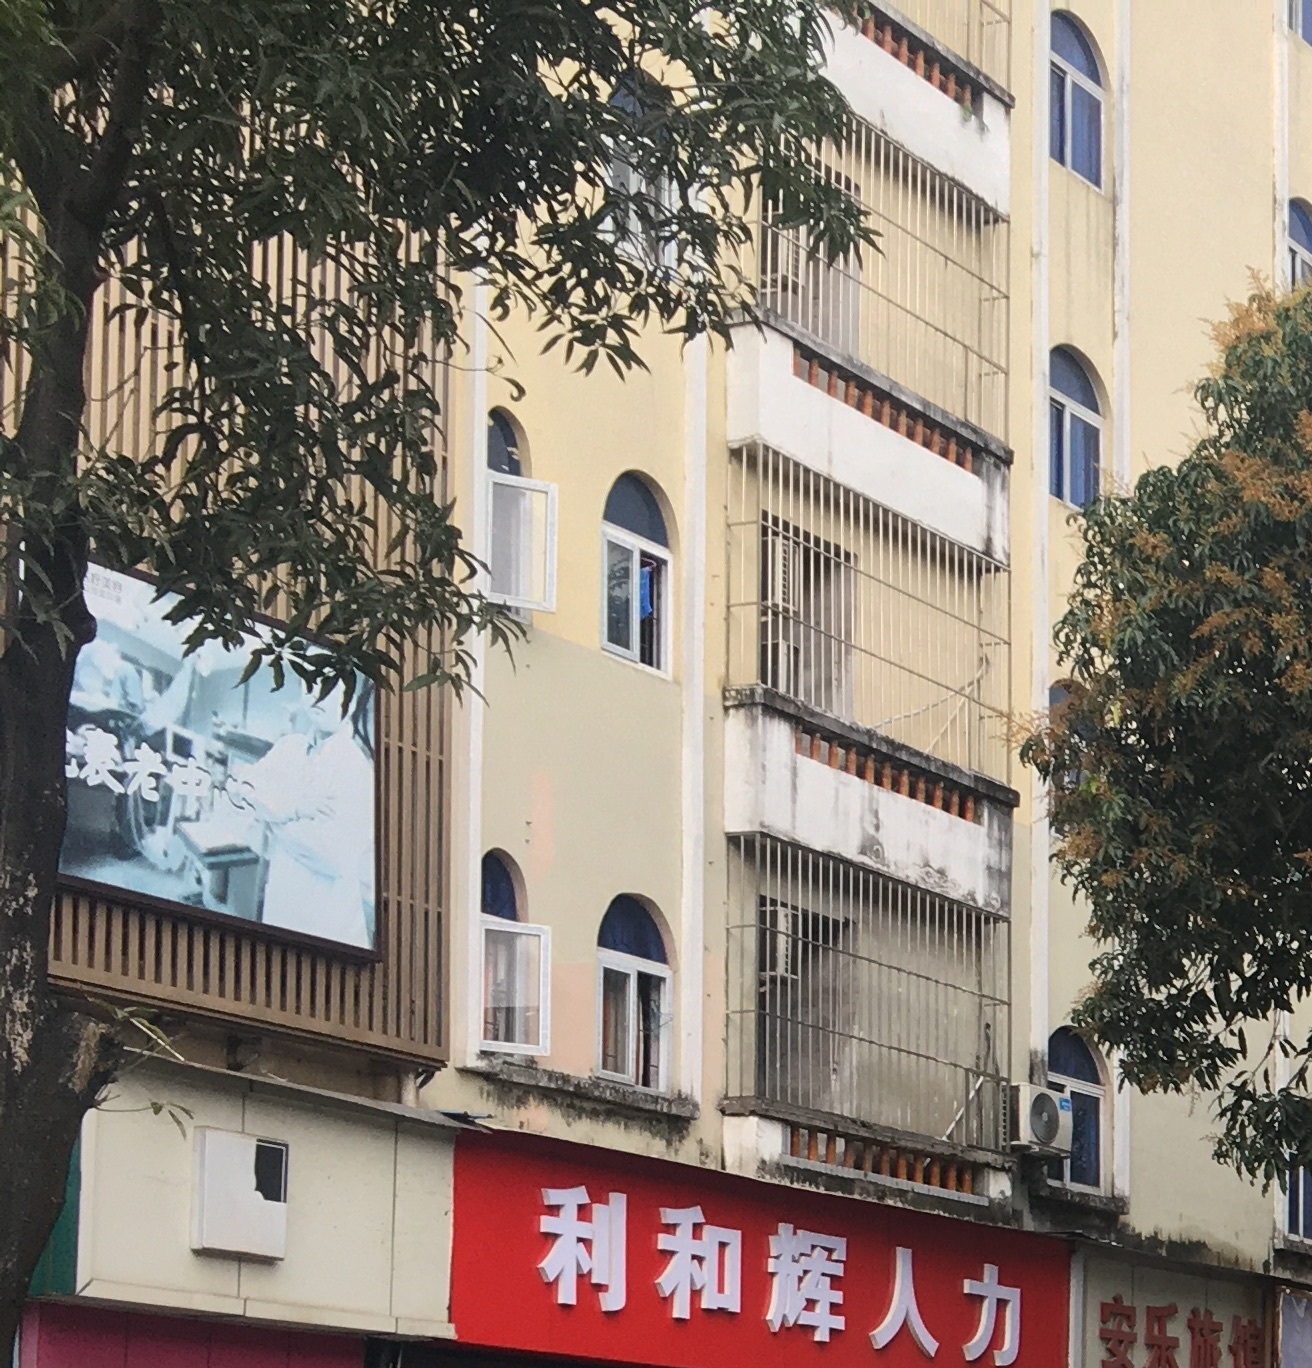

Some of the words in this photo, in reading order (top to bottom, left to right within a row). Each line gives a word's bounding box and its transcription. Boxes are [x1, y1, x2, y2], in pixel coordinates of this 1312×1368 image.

[537, 1186, 1023, 1367] 利和辉人力
